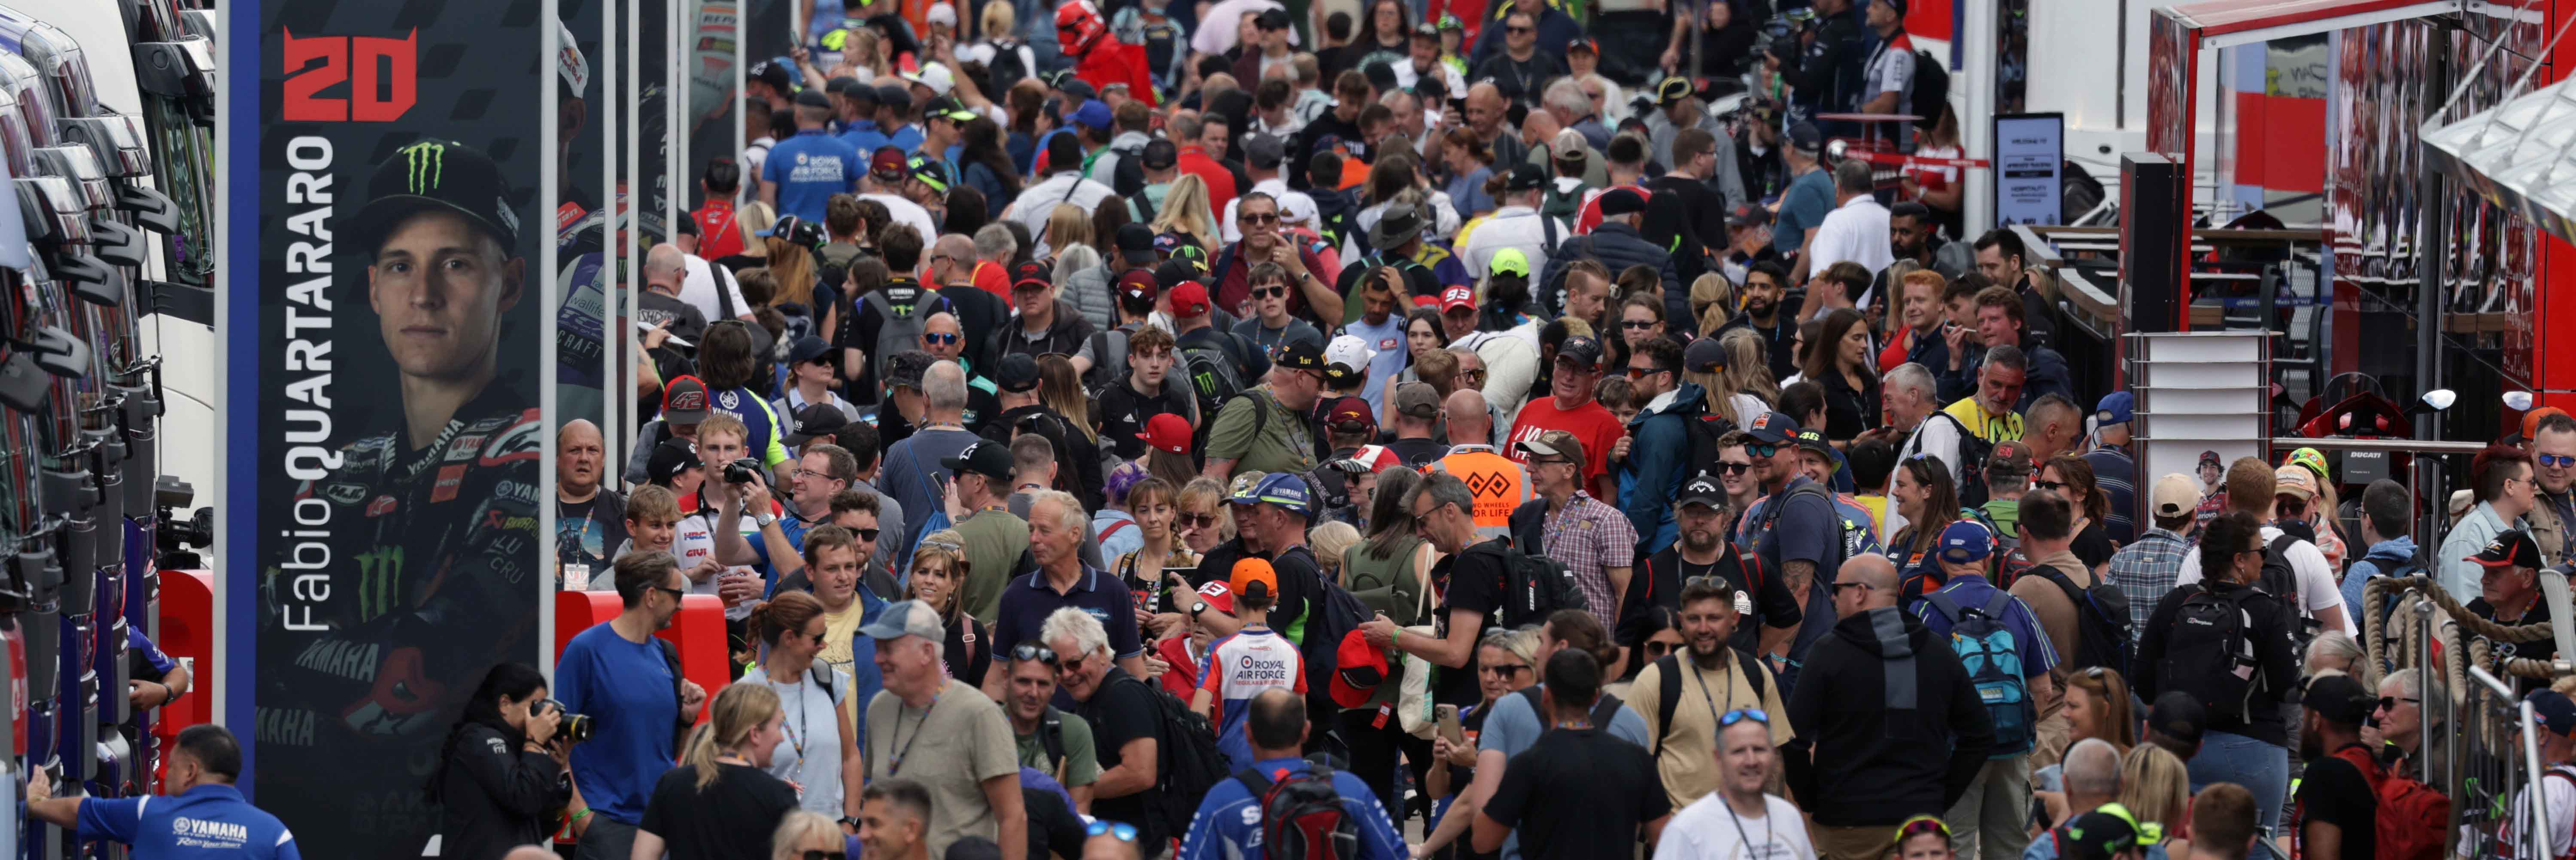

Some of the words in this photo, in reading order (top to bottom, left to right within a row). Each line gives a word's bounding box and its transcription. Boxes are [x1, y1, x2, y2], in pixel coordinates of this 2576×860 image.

[284, 24, 417, 121] 20
[1446, 289, 1470, 302] 93
[285, 135, 343, 480] QUARTARARO
[1299, 356, 1312, 365] 1ST
[670, 391, 703, 410] 42
[1799, 432, 1820, 441] 46
[1689, 480, 1716, 492] Callaway
[1279, 488, 1301, 500] YAMAHA
[1473, 509, 1486, 518] OR
[1490, 509, 1510, 518] LIFE
[686, 549, 707, 557] GIVI
[282, 498, 331, 631] Fabio
[1197, 581, 1228, 597] 93
[296, 639, 380, 683] YAMAHA
[1255, 661, 1285, 669] ROYAL
[1236, 671, 1254, 679] AIR
[1255, 671, 1285, 679] FORCE
[191, 819, 248, 839] YAMAHA
